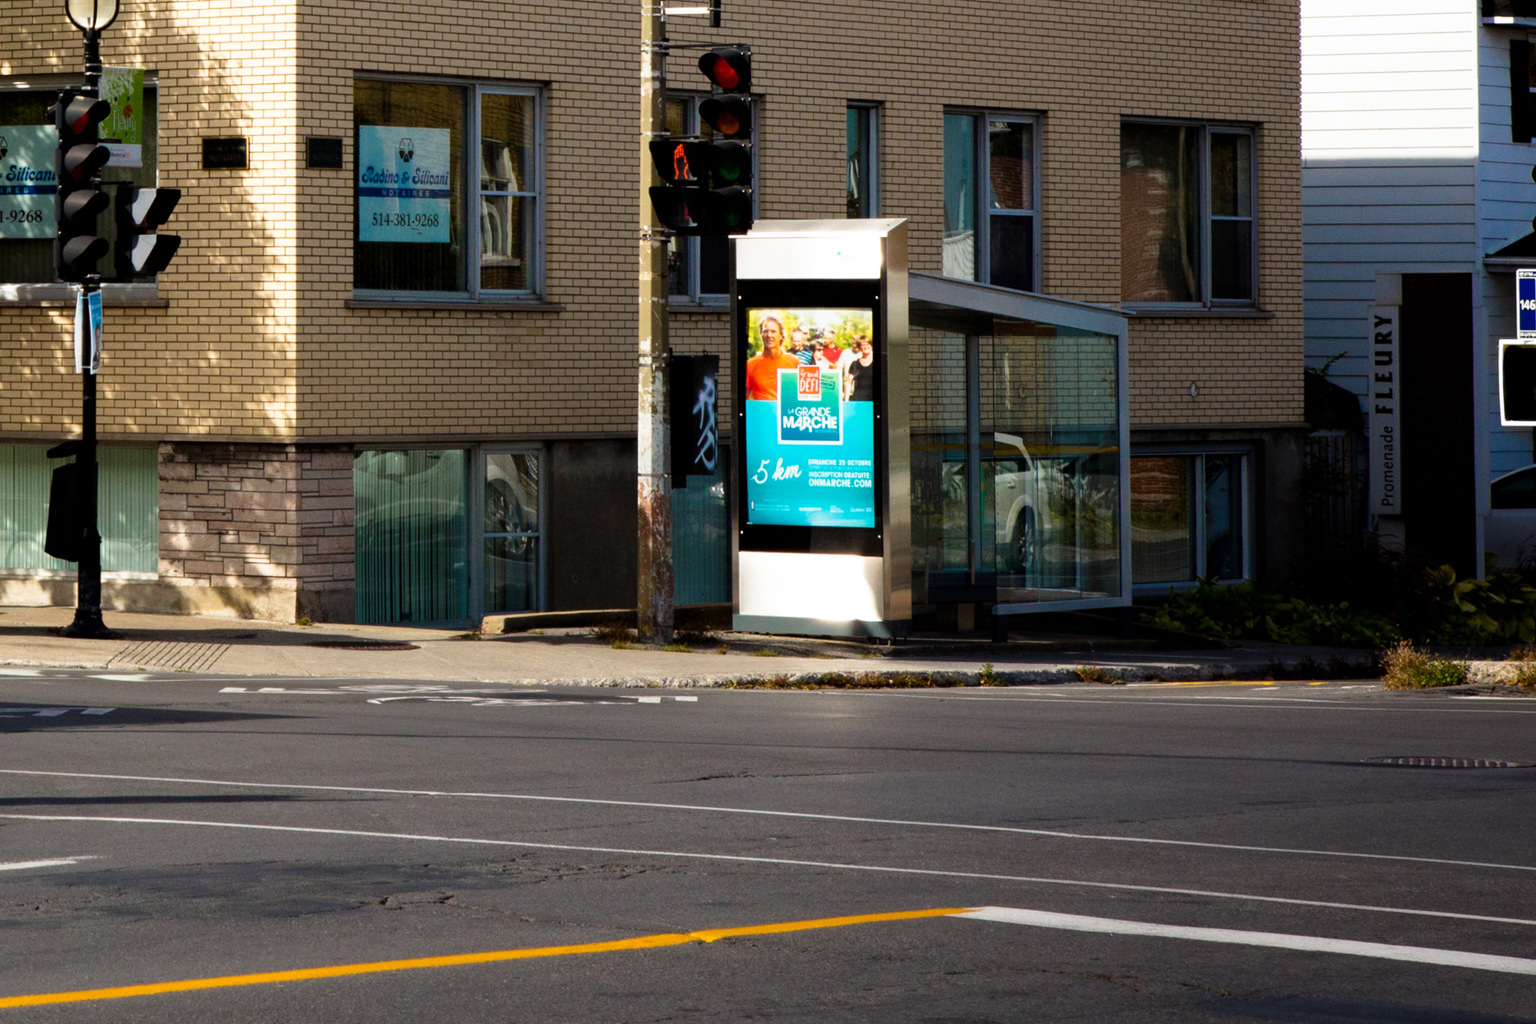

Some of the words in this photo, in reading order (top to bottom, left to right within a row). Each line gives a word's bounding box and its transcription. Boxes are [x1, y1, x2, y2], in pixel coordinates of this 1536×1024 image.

[361, 165, 400, 184] Radino
[401, 171, 410, 184] &
[412, 167, 449, 185] Silicani
[371, 212, 440, 227] 514-381-9268
[1520, 299, 1535, 311] 146
[1375, 315, 1393, 414] FLEURY
[799, 378, 819, 393] DÉFI
[795, 407, 832, 417] GRANDE
[783, 416, 838, 433] MARCHE
[808, 458, 837, 466] DIMANCHE
[1381, 425, 1394, 507] Promenade
[750, 459, 770, 484] 5
[772, 457, 803, 481] km
[808, 478, 872, 487] ONMARCHE.COM
